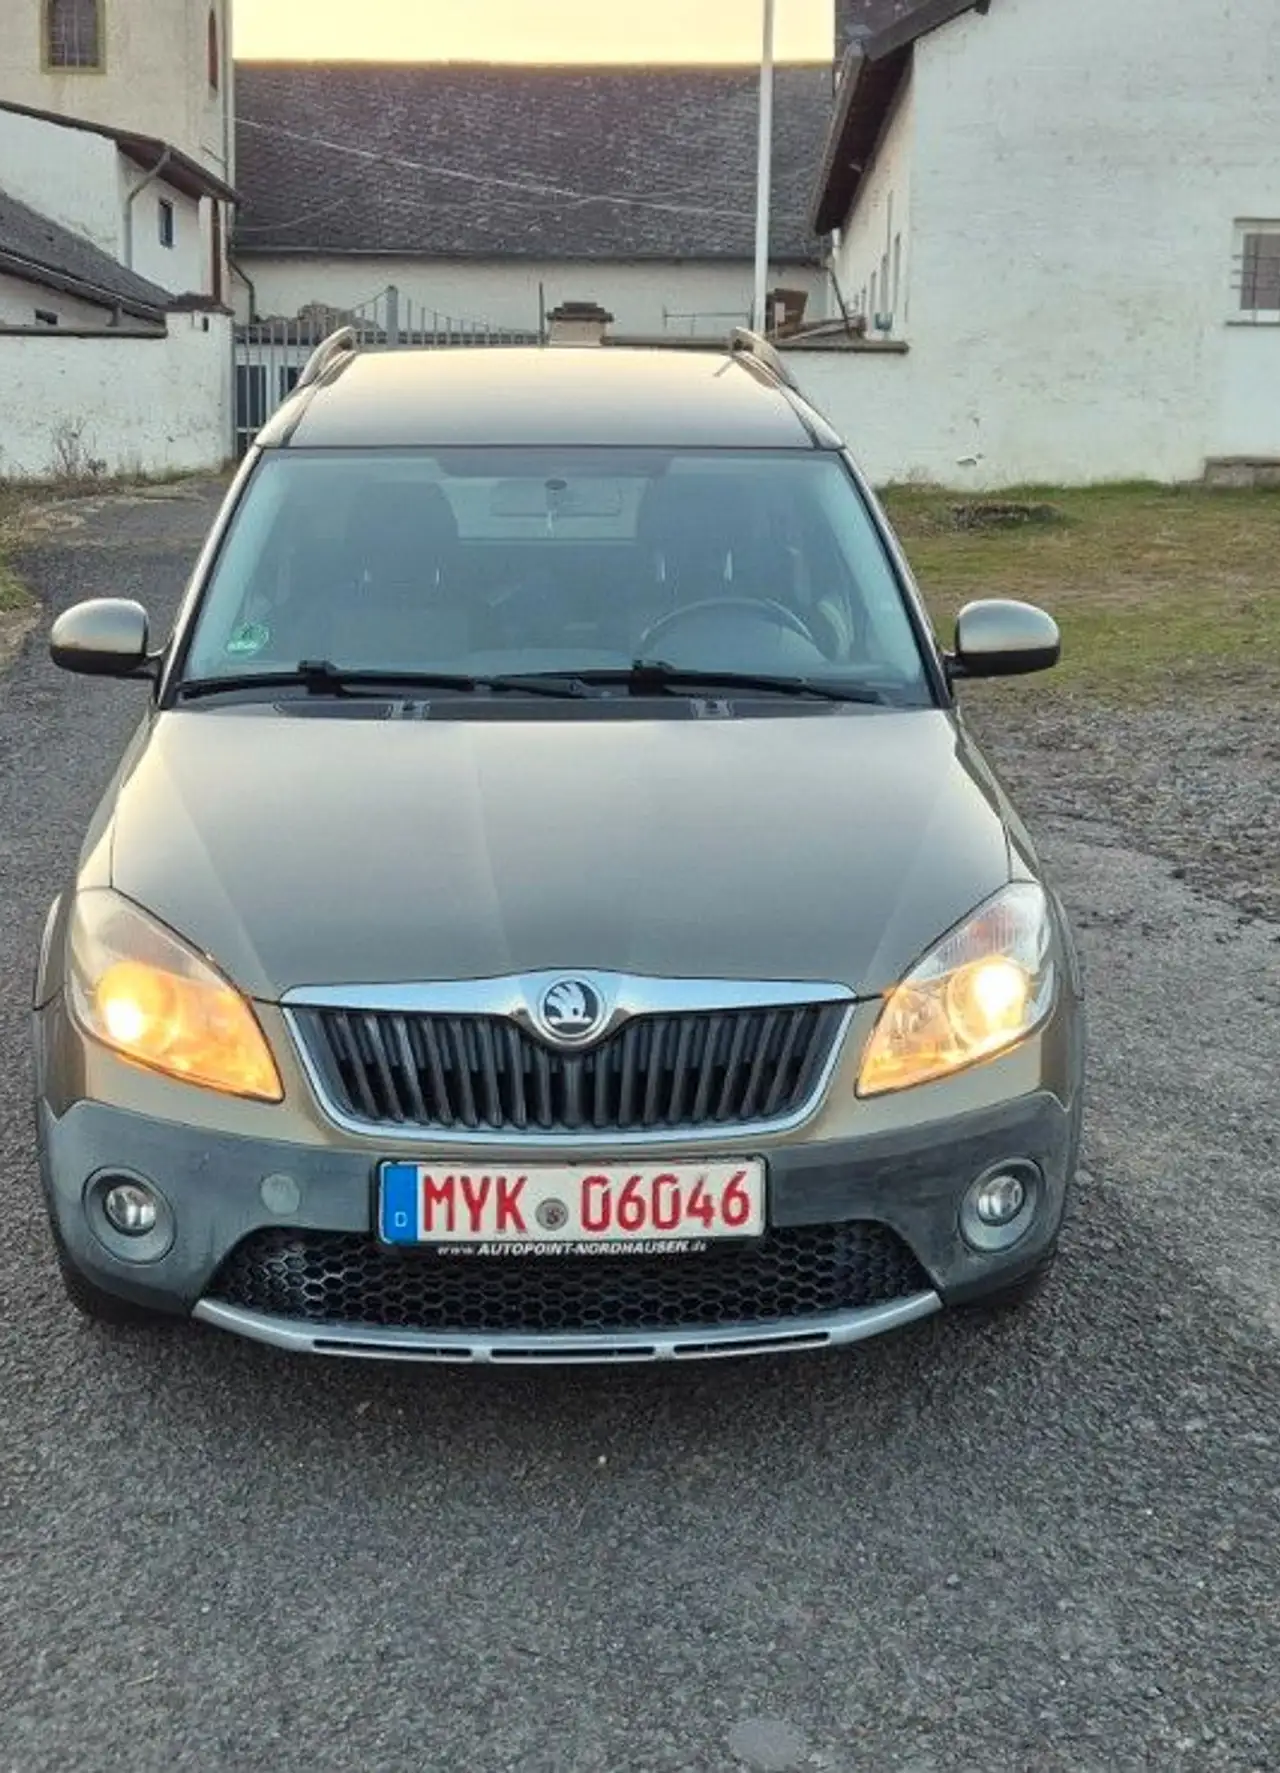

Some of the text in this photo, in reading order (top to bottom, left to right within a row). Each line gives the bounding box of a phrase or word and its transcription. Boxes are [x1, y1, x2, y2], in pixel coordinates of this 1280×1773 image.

[394, 1170, 751, 1233] D MYK 06046
